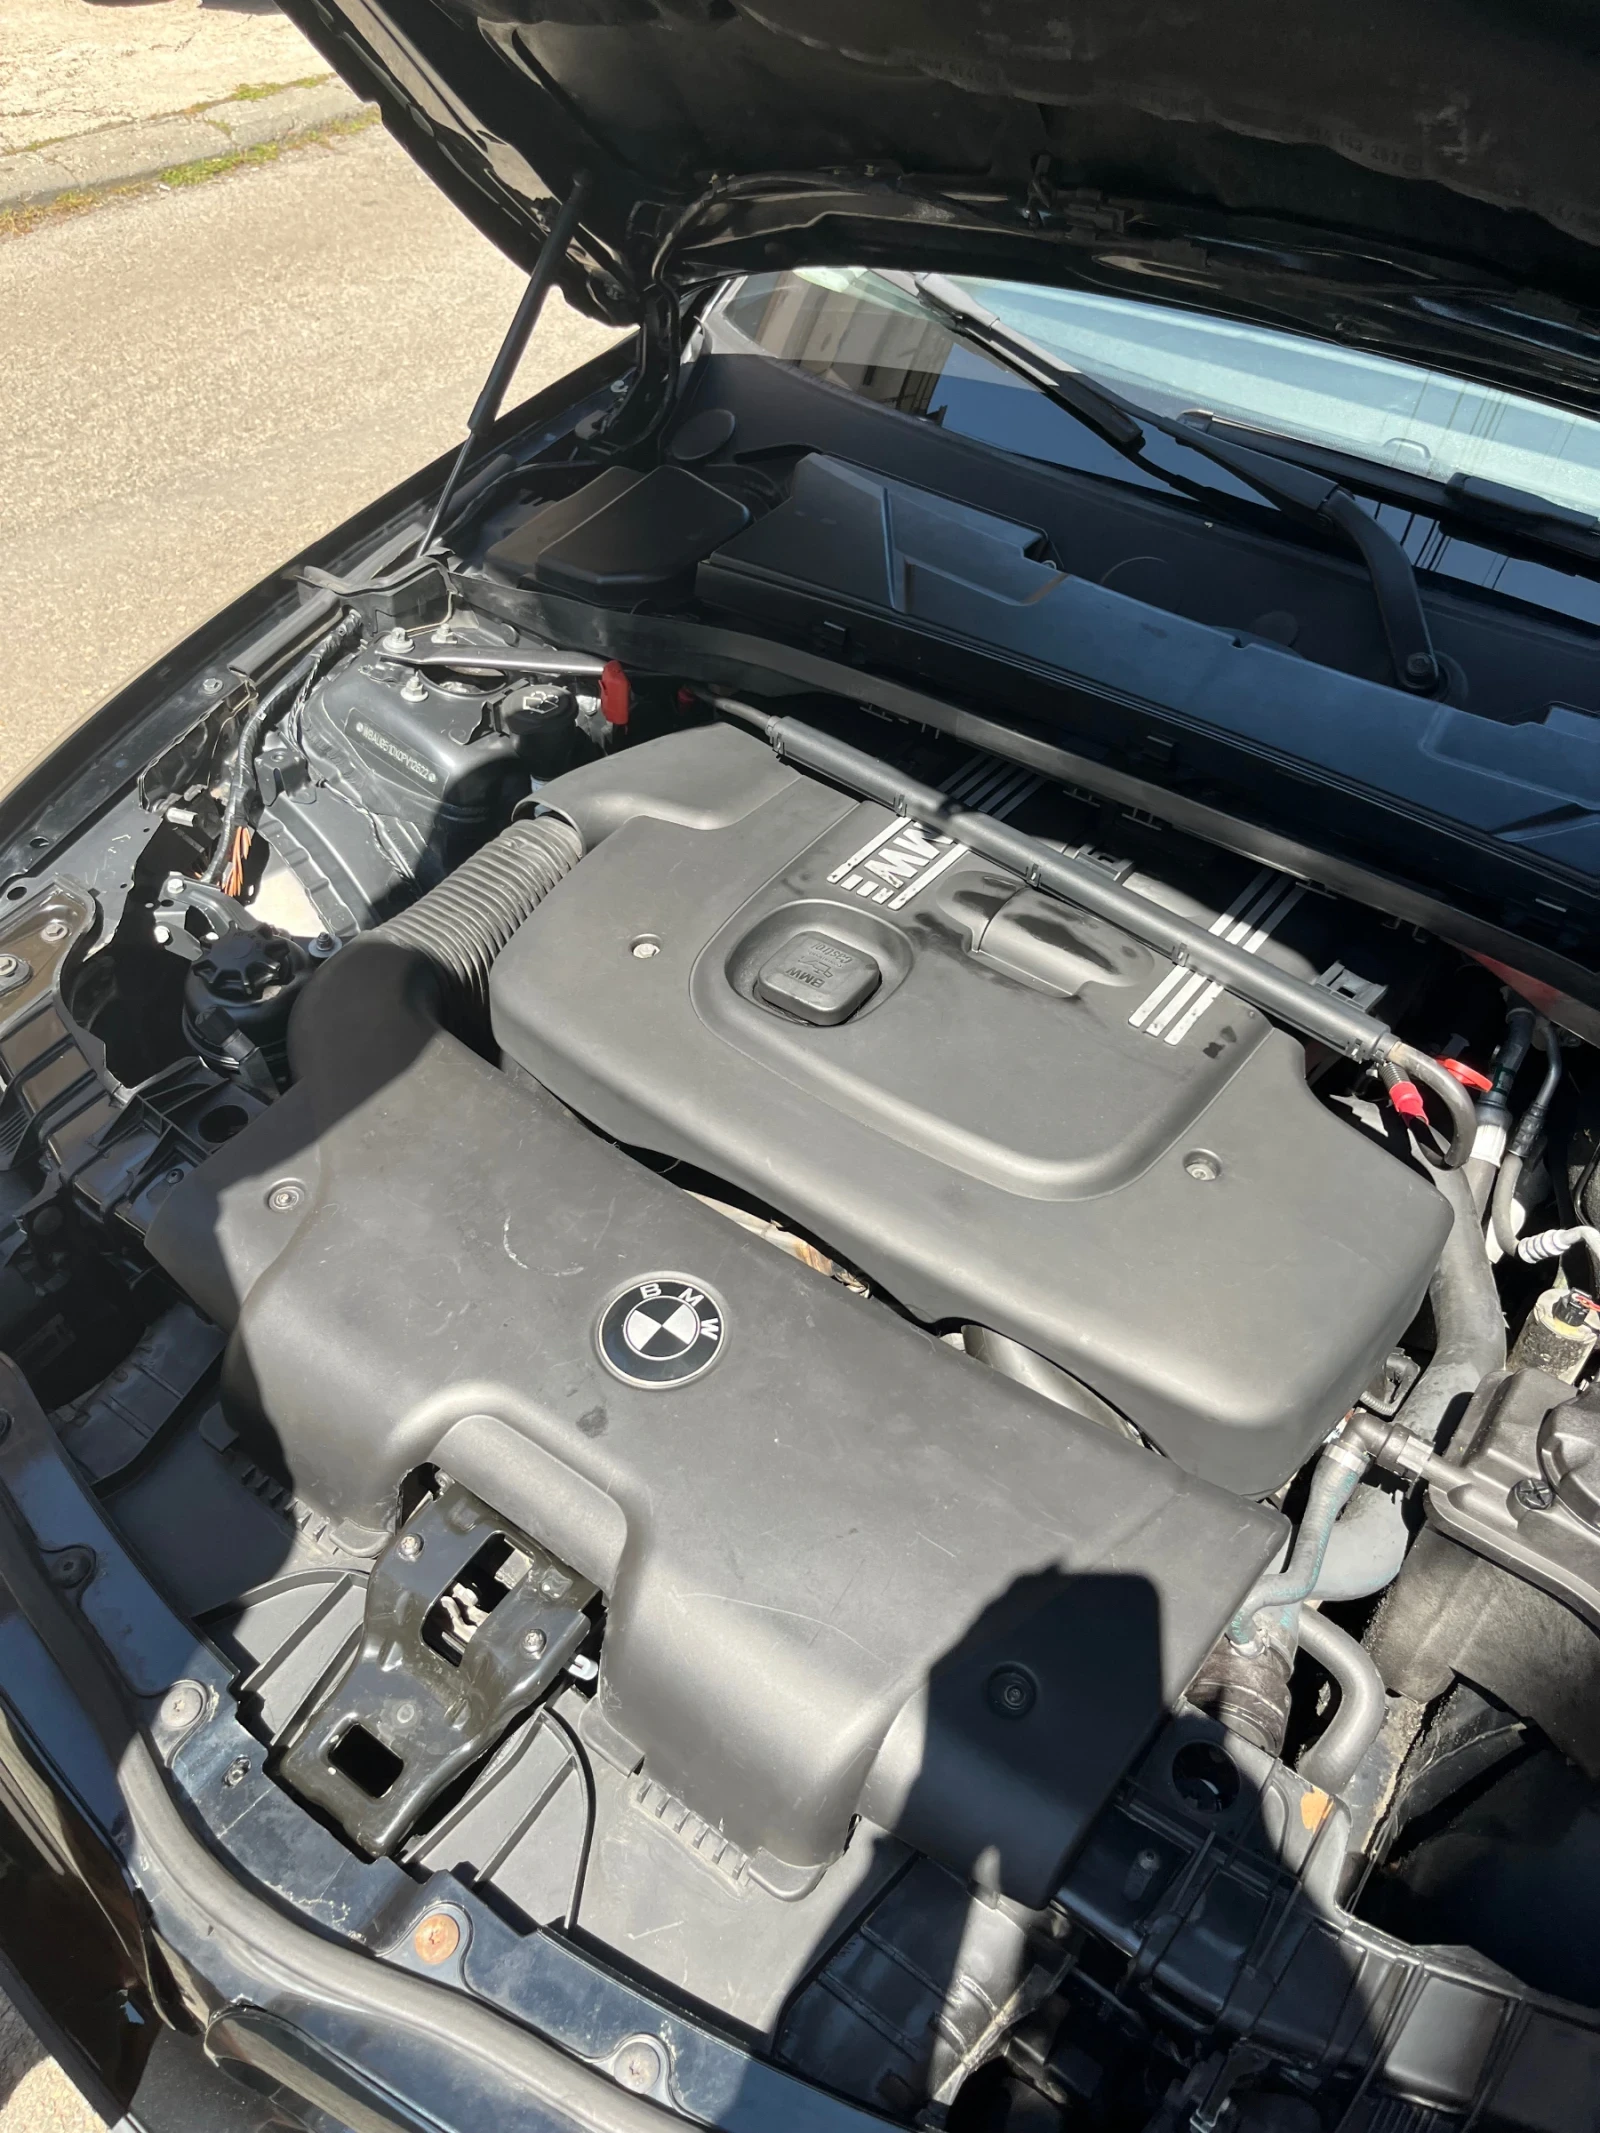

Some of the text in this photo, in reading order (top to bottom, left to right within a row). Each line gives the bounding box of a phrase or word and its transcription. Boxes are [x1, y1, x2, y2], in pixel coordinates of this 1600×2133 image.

[810, 942, 853, 964] Castrol
[785, 966, 826, 989] BMW
[639, 1282, 720, 1341] BMW
